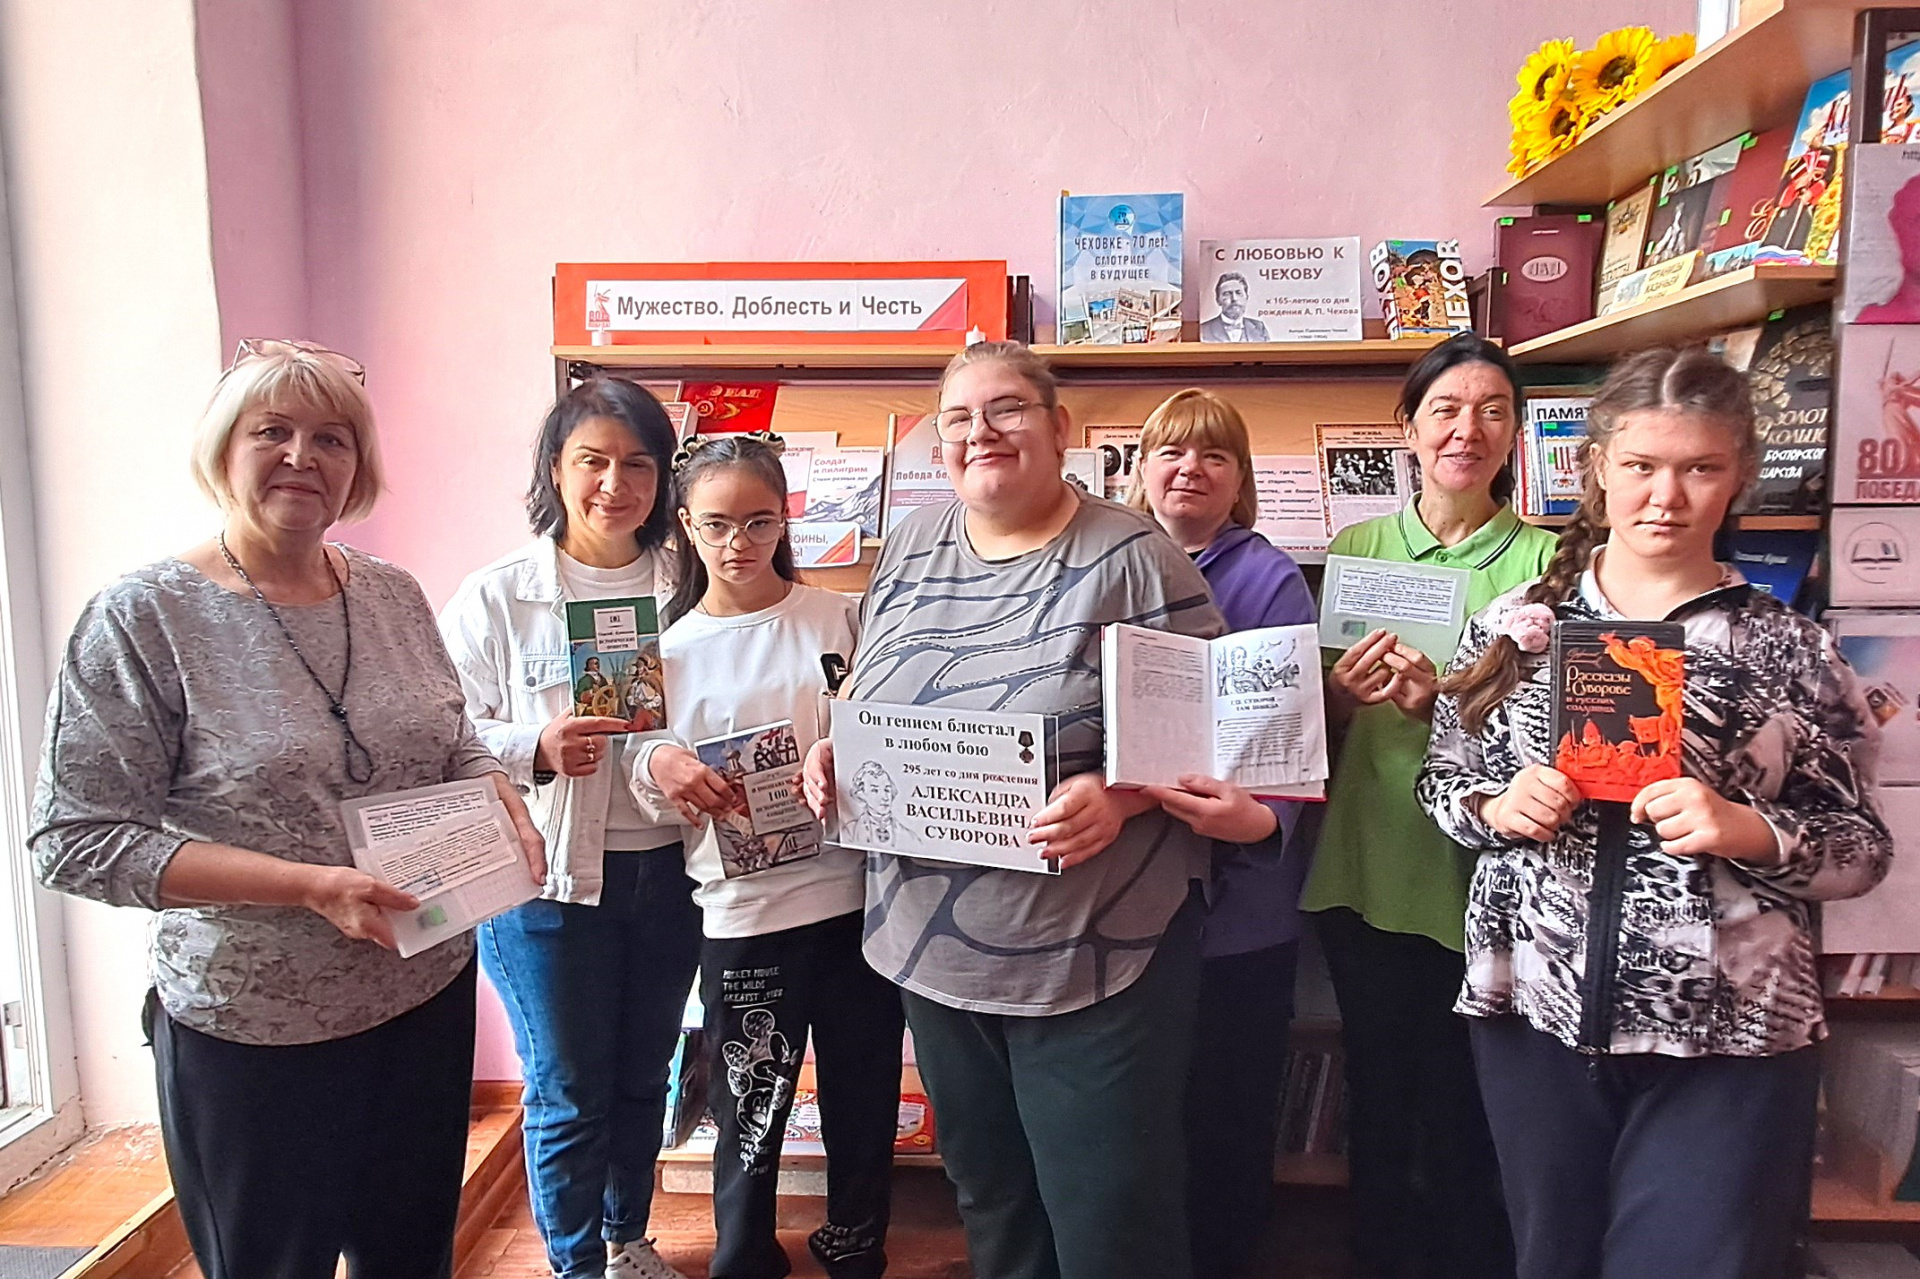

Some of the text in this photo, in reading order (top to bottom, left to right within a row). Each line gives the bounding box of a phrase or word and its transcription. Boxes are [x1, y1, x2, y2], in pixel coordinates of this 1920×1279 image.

[1074, 236, 1122, 251] ЧЕХОВКЕ
[1133, 235, 1145, 249] 70
[1148, 235, 1168, 249] лет!
[1094, 255, 1145, 267] СМОТРИМ
[1215, 246, 1344, 261] С ЛЮБОВЬЮ К
[1090, 269, 1150, 281] В БУДУЩЕЕ
[1259, 267, 1323, 280] ЧЕХОВУ
[617, 295, 922, 320] Мужество. Доблесть и Честь
[1274, 297, 1319, 305] 165-летию
[1333, 298, 1350, 306] дня
[1258, 308, 1302, 318] рождения
[1327, 308, 1359, 316] Чехова
[814, 458, 847, 467] Солдат
[1857, 438, 1903, 474] 80
[821, 467, 868, 475] пилигрим
[895, 469, 950, 481] Победа бе
[1856, 481, 1920, 501] ПОБЕД
[1566, 665, 1632, 687] Рассказы
[858, 710, 1016, 737] Он гением блистал
[885, 738, 989, 757] в любом бою
[903, 763, 1039, 786] 295 лет со дня рождения
[768, 788, 789, 802] 100
[910, 785, 1031, 810] АЛЕКСАНДРА
[924, 825, 1021, 848] СУВОРОВА
[723, 981, 740, 991] THE
